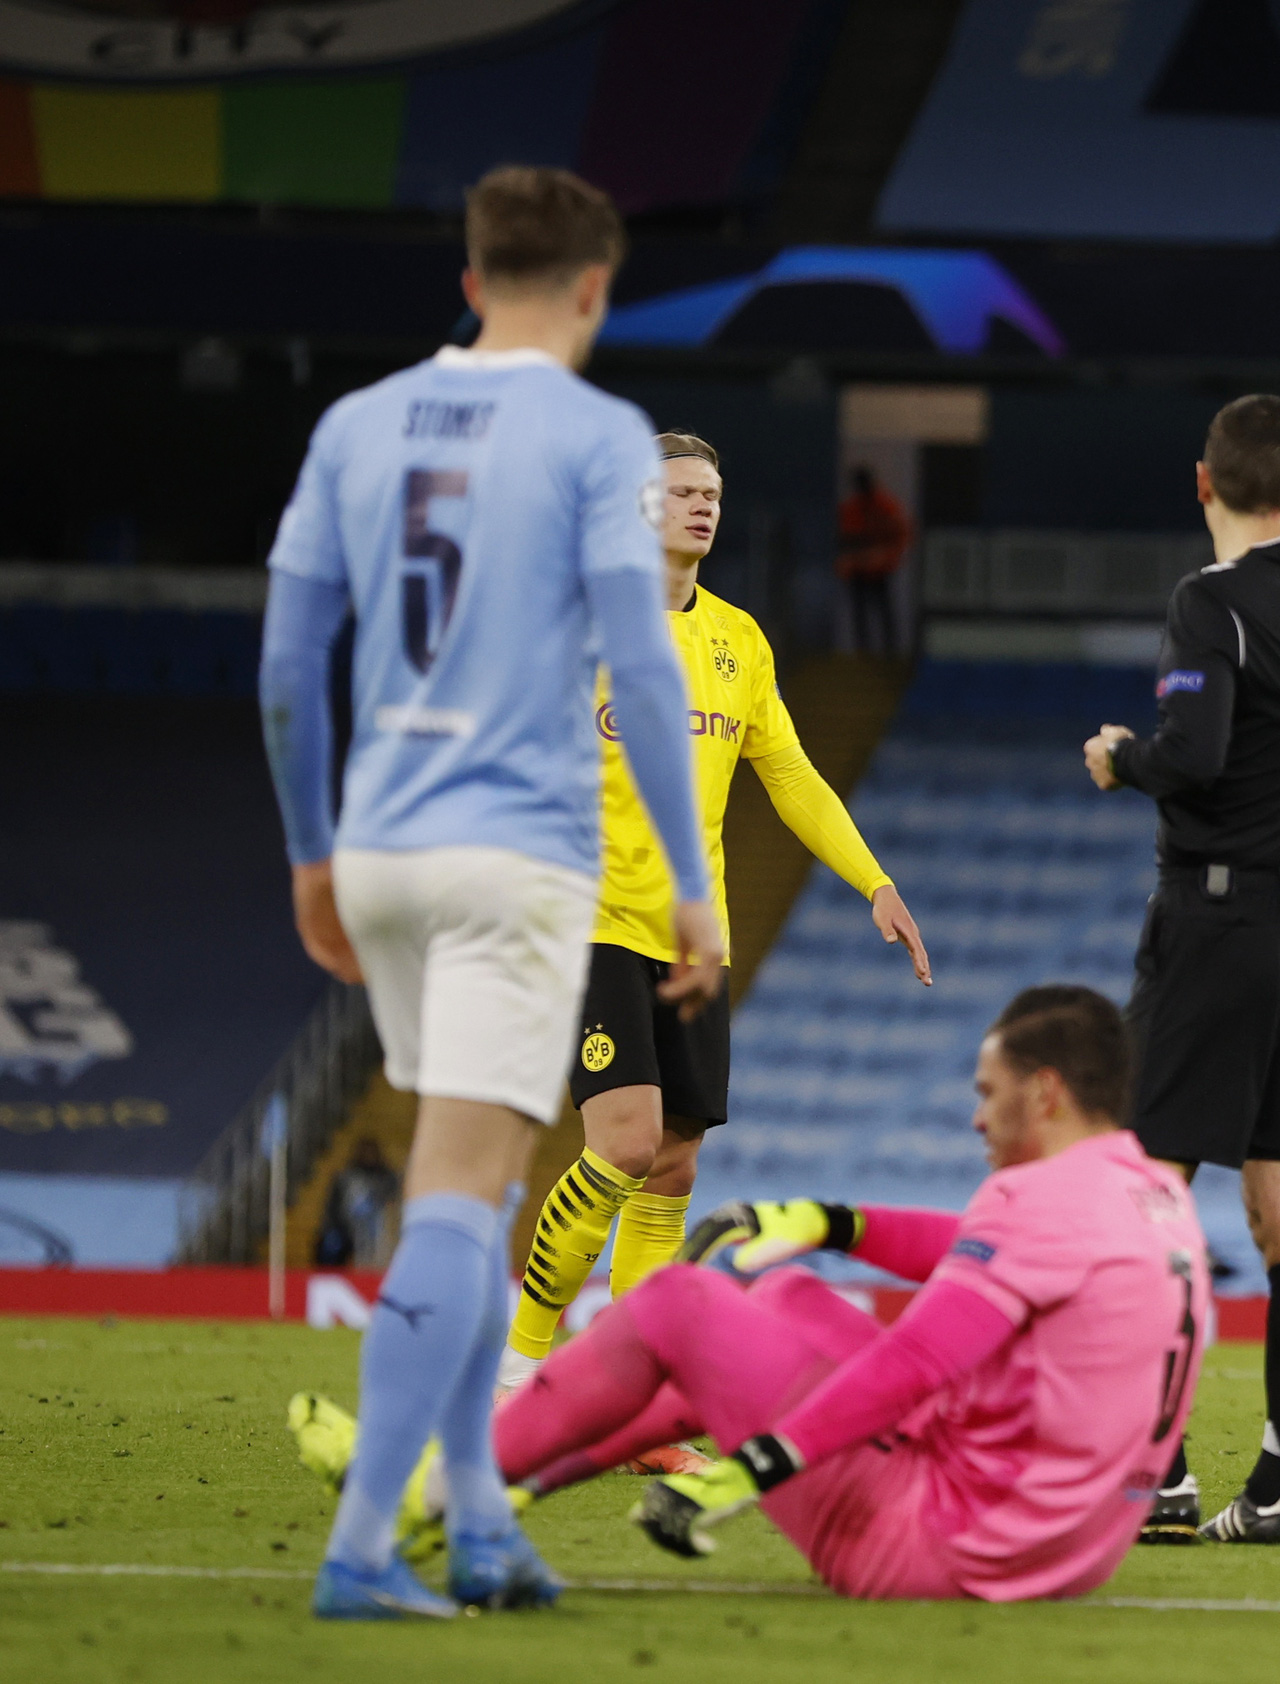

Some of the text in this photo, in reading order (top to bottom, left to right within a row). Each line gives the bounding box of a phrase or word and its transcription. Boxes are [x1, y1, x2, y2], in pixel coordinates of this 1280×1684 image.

[402, 467, 468, 677] 5
[714, 650, 736, 673] BVB
[585, 1037, 610, 1063] BVB
